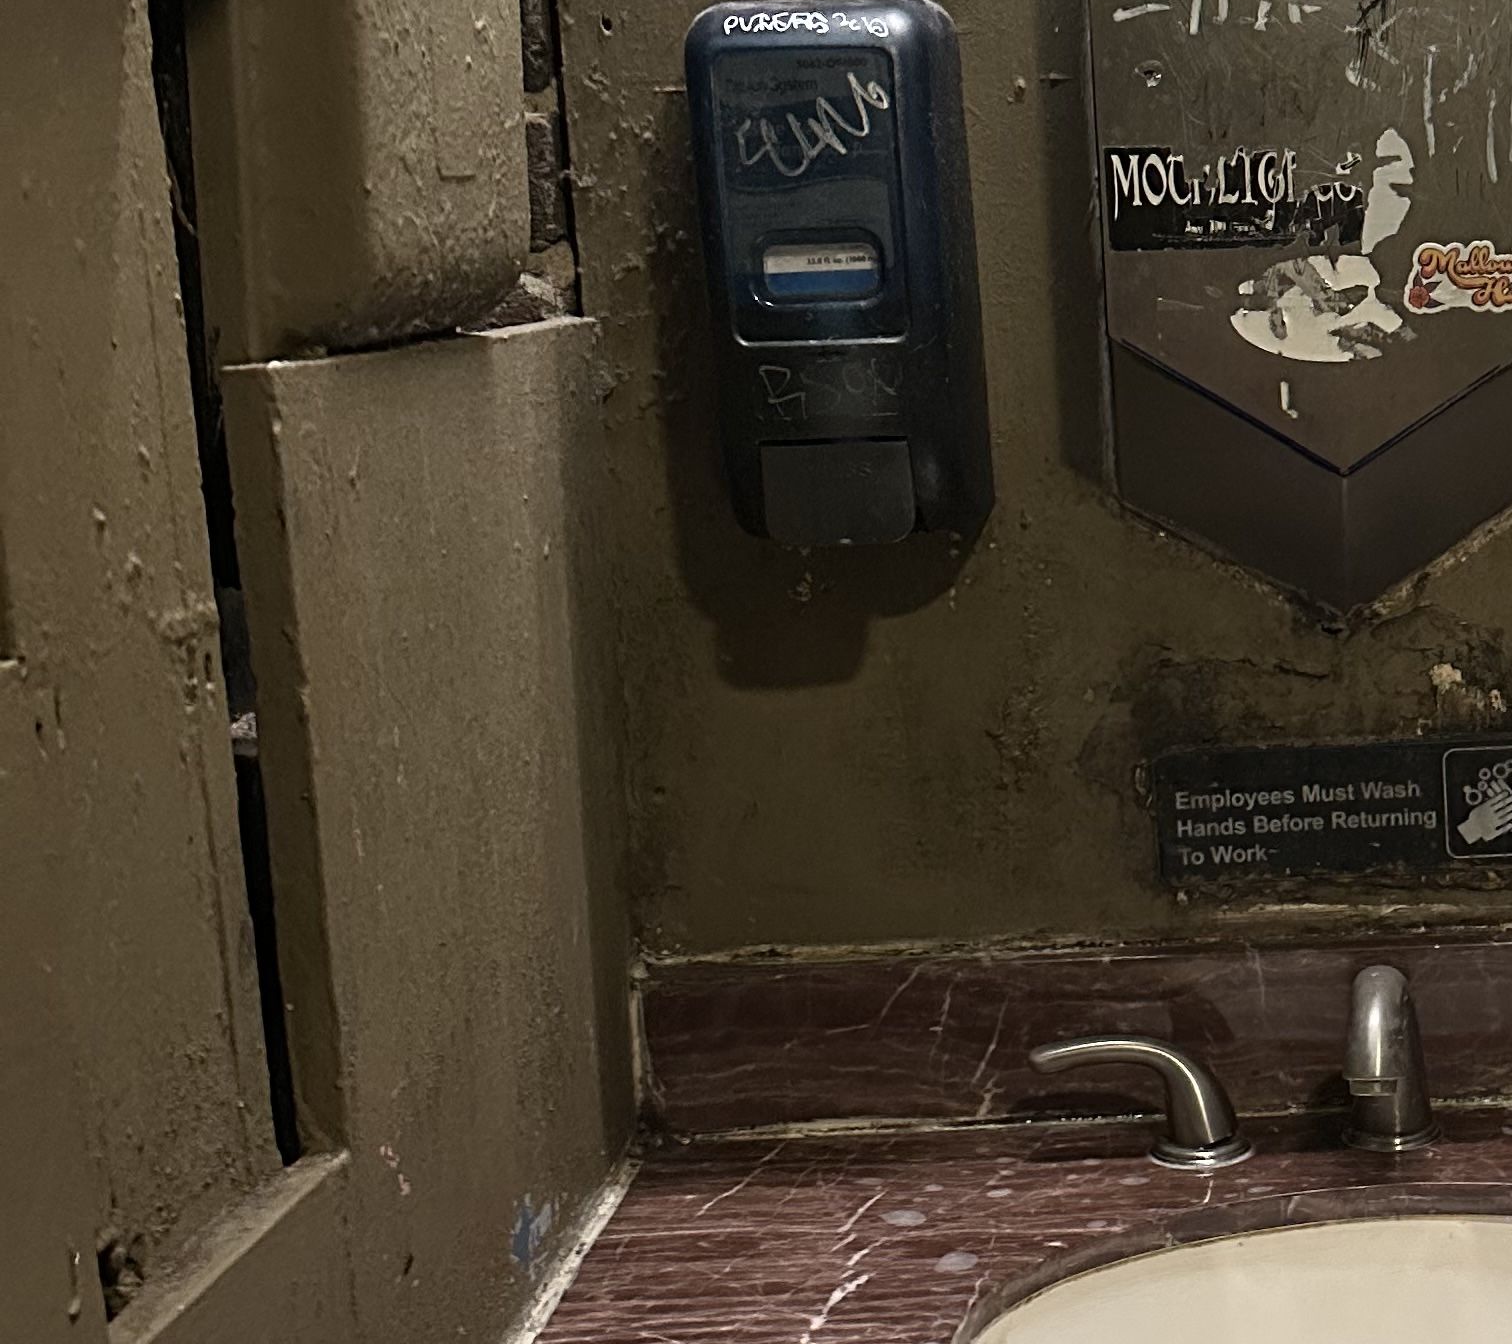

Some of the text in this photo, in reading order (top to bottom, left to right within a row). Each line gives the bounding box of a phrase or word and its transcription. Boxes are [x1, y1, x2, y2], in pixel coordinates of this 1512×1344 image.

[1174, 780, 1421, 812] Employees Must Wash
[1176, 808, 1437, 839] Hands Before Returning
[1178, 844, 1268, 866] To Work
